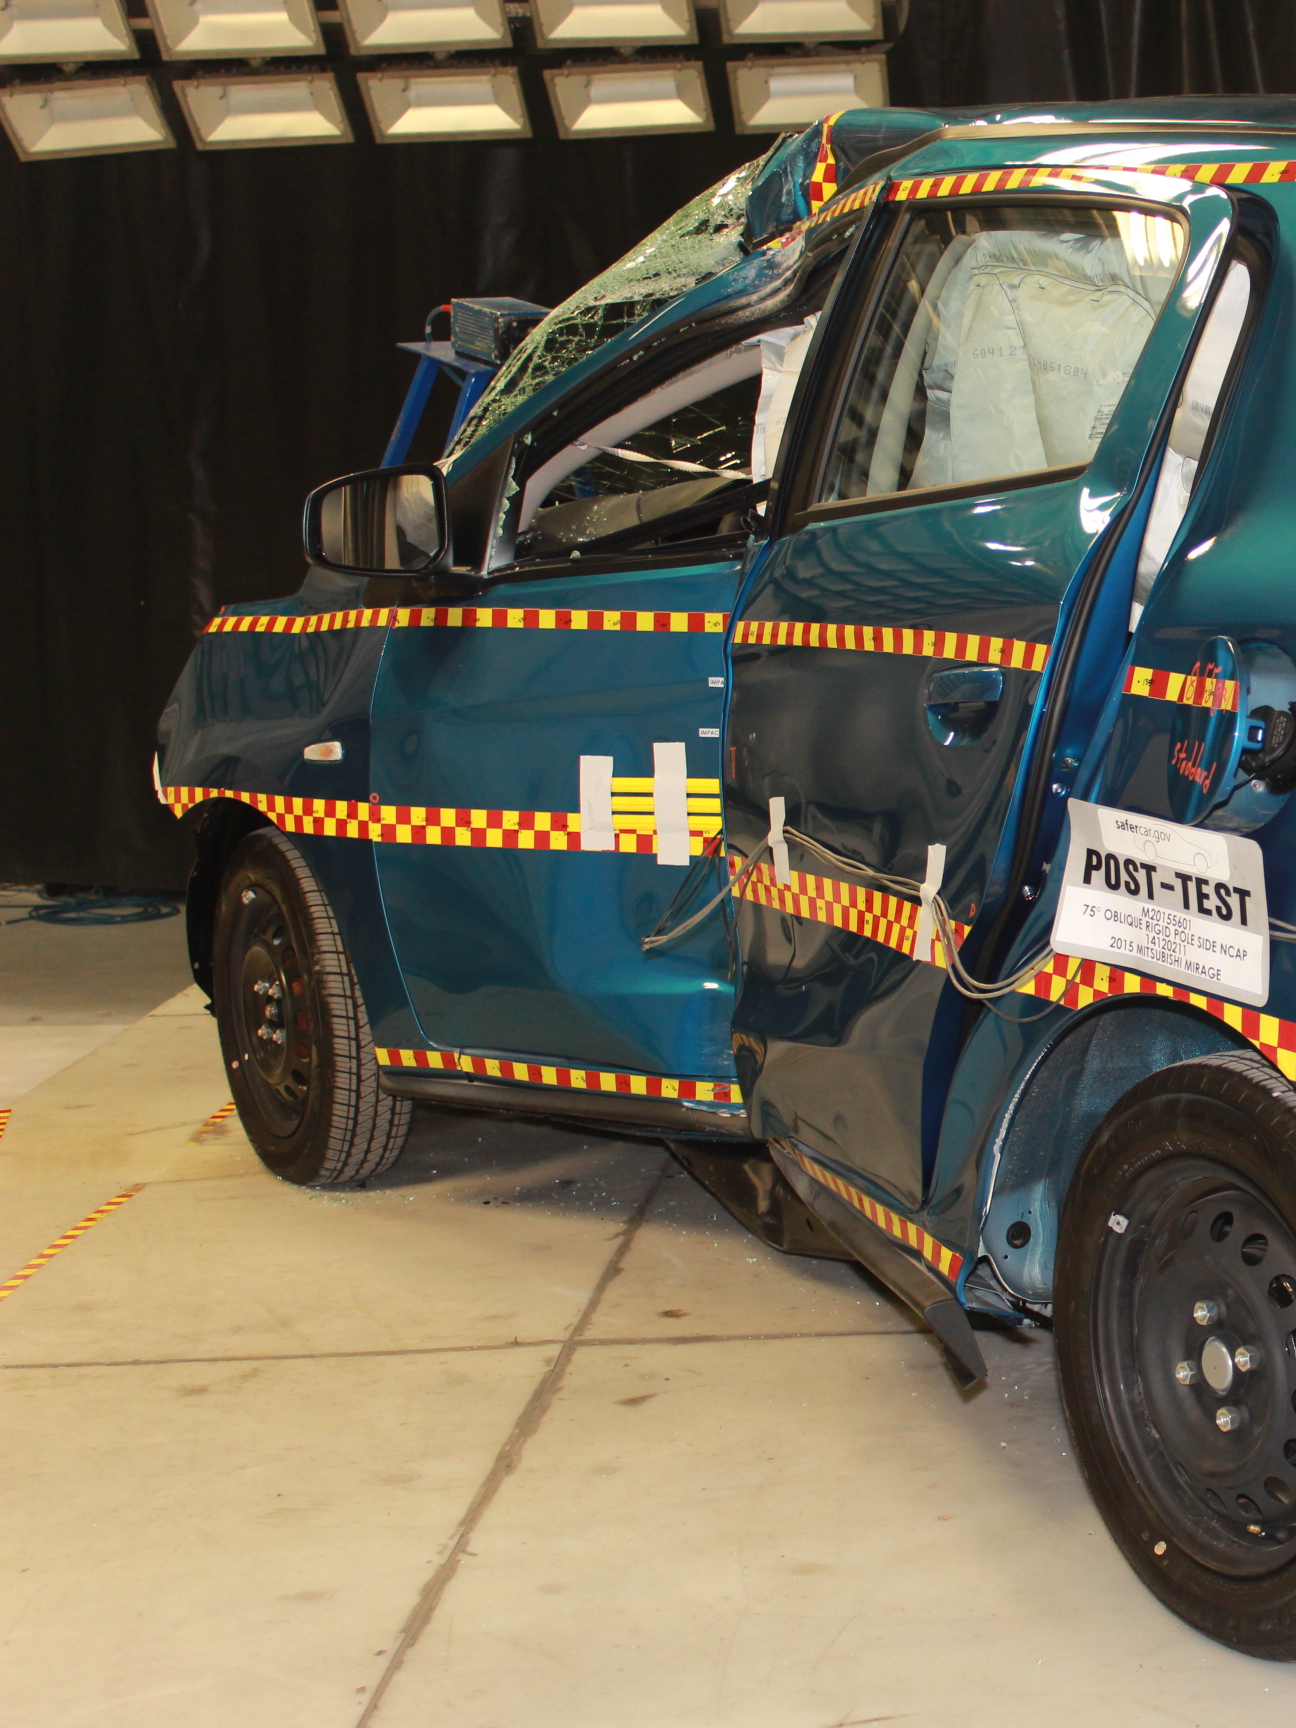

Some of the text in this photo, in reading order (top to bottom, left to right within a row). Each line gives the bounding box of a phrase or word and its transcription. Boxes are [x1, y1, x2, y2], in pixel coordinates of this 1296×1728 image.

[1114, 818, 1172, 844] safercar.gov
[1082, 847, 1251, 927] POST-TEST
[1104, 908, 1144, 931] OBLIQUE
[1145, 921, 1171, 939] RIGID
[1174, 929, 1196, 947] POLE
[1197, 935, 1218, 953] SIDE
[1220, 943, 1248, 962] NCAP
[1141, 906, 1193, 932] M20155601
[1109, 936, 1222, 982] 2015 MITSUBISHI MIRAGE
[1145, 934, 1187, 957] 14120211
